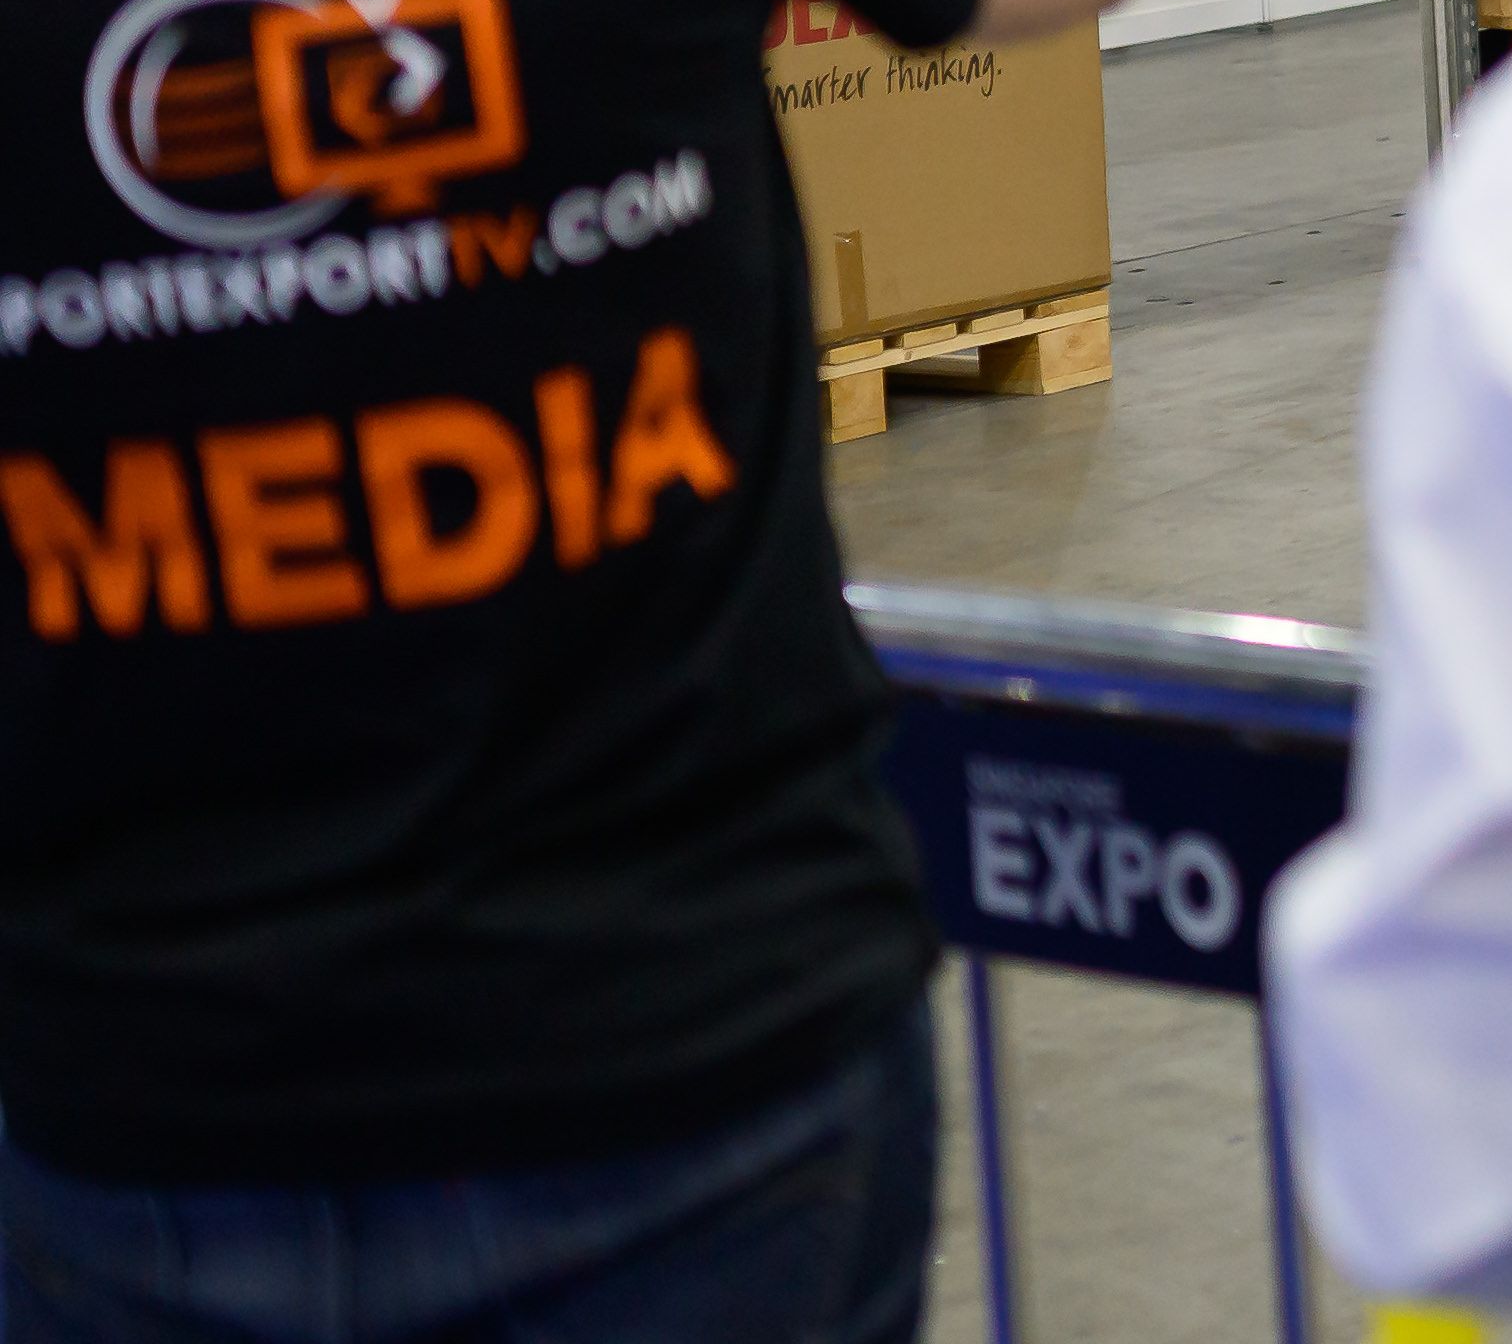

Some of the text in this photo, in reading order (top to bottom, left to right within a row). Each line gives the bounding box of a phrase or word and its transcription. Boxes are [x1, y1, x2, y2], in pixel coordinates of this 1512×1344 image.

[764, 65, 871, 114] marter
[0, 325, 738, 640] MEDIA
[966, 803, 1242, 953] EXPO
